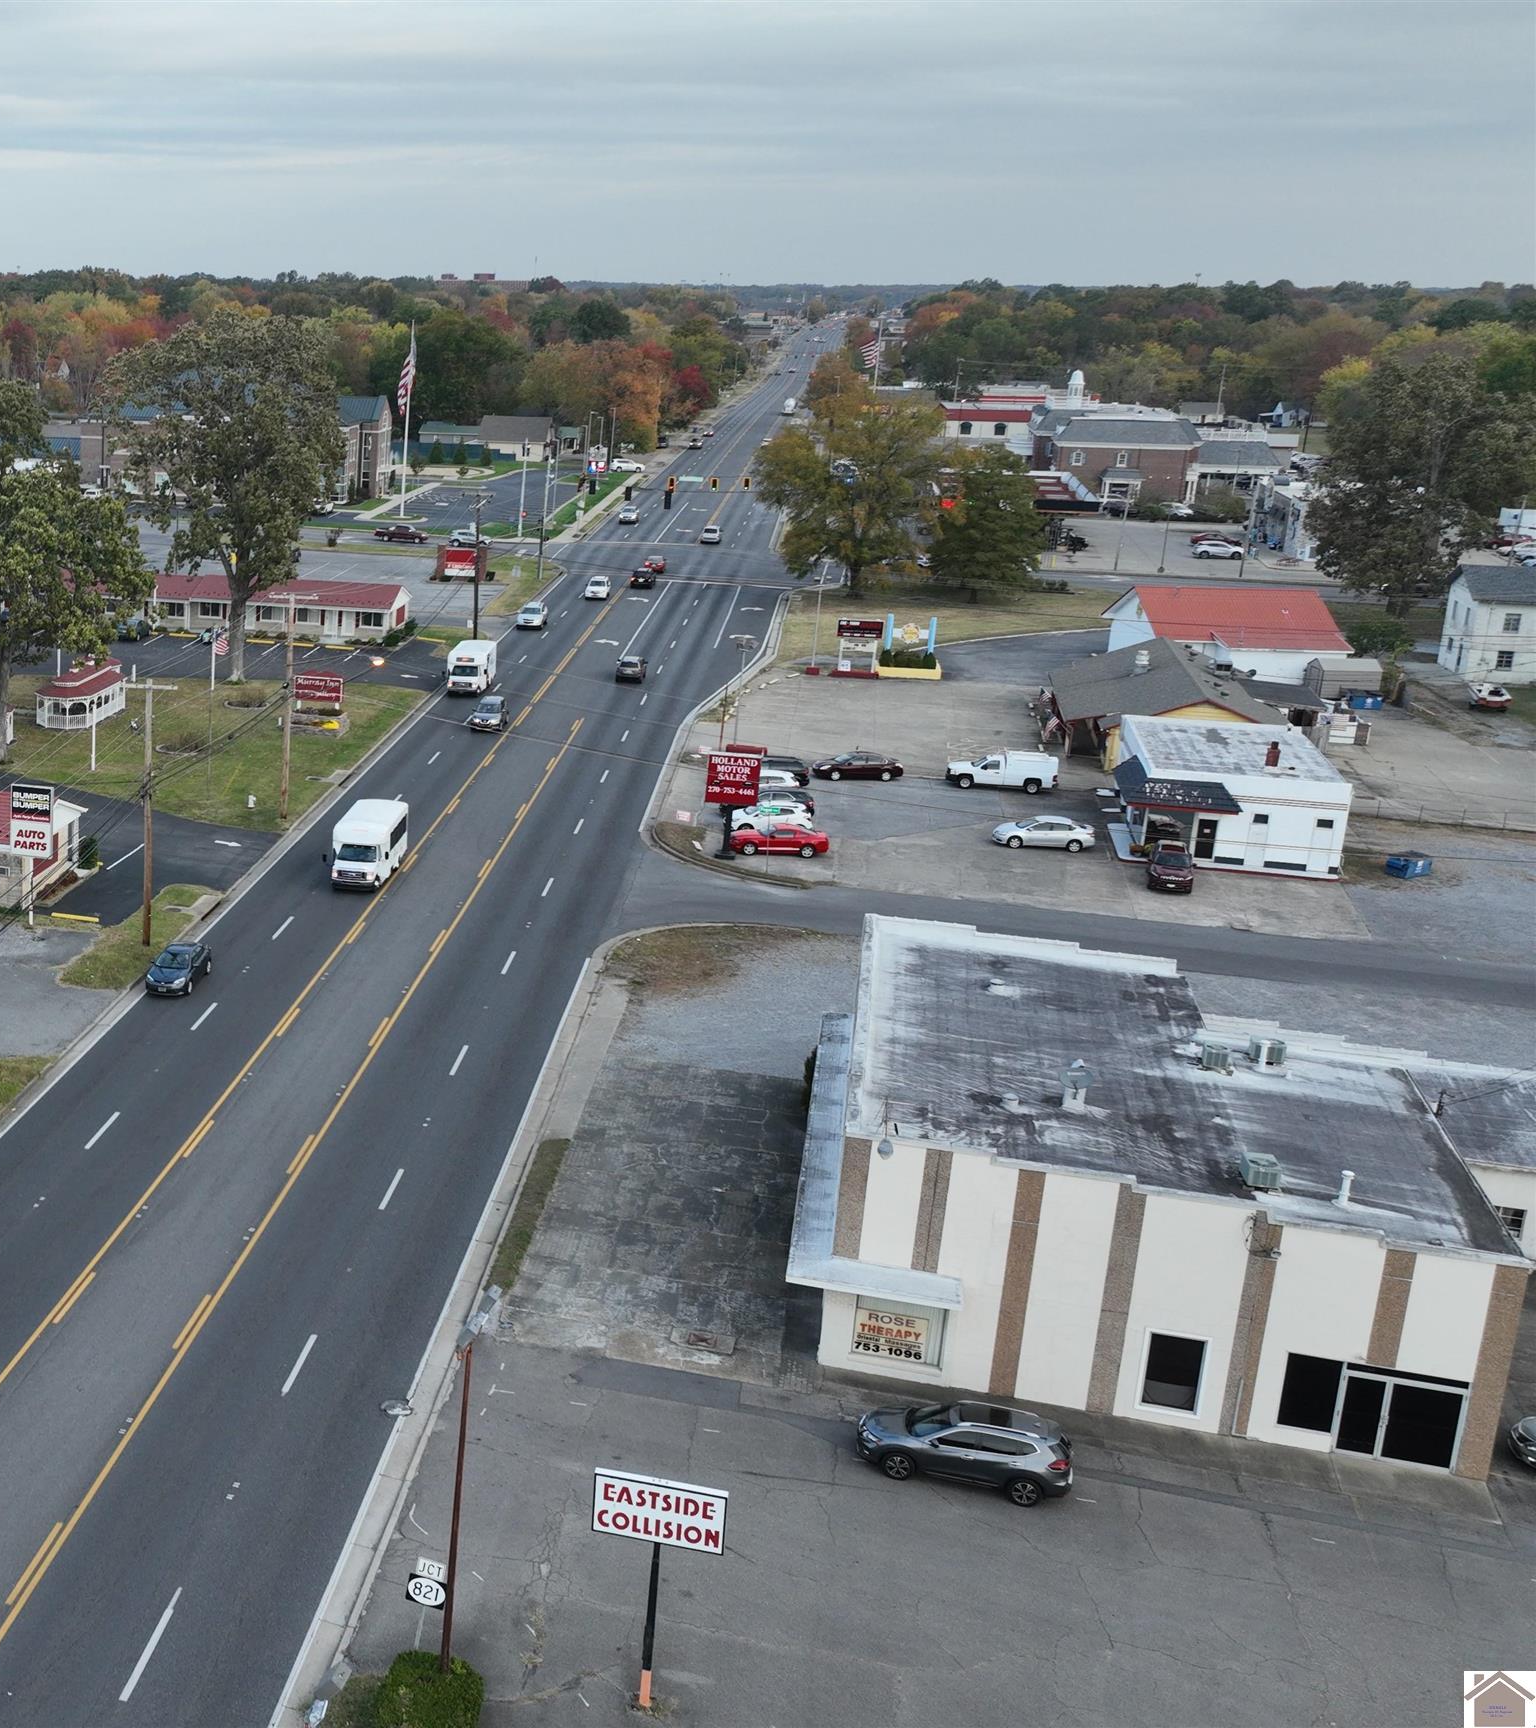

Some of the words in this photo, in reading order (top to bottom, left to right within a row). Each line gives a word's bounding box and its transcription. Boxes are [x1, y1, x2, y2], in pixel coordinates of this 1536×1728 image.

[711, 756, 758, 767] HOLLAND
[716, 765, 751, 774] MOTOR
[717, 773, 748, 782] SALES
[13, 791, 50, 801] BUMPER
[707, 785, 755, 796] 270-753-4461
[13, 801, 50, 810] BUMPER
[16, 829, 46, 840] AUTO
[14, 840, 47, 851] PARTS
[868, 1312, 916, 1329] ROSE
[859, 1323, 922, 1341] THERAPY
[854, 1341, 922, 1360] 753-1096
[603, 1482, 716, 1521] EASTSIDE
[596, 1509, 720, 1549] COLLISION
[418, 1560, 443, 1579] JCT
[412, 1581, 440, 1602] 821
